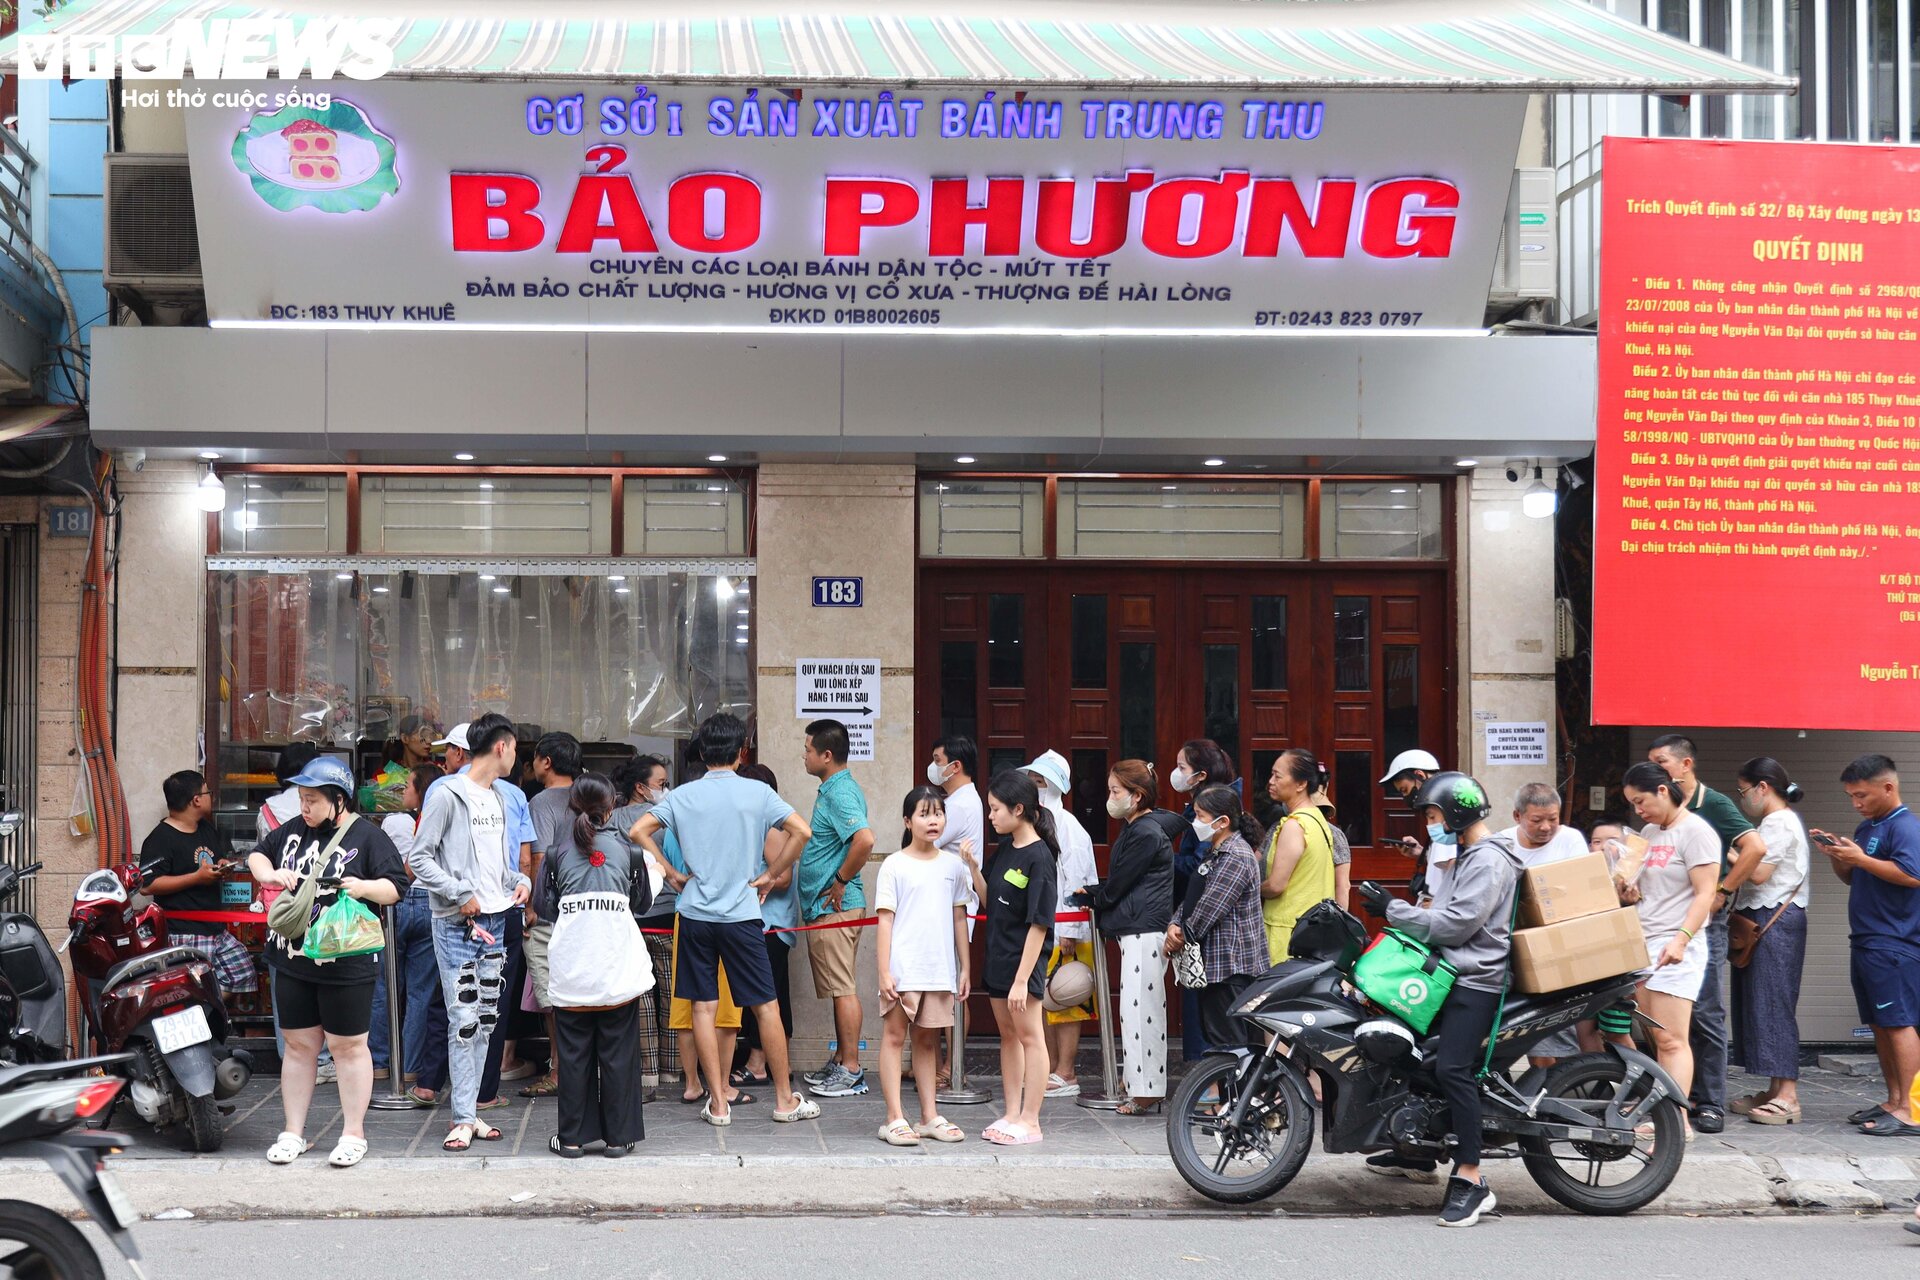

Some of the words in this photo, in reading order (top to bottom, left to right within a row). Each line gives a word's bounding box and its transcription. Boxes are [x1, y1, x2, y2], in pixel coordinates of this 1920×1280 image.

[526, 93, 584, 136] CƠ
[600, 85, 658, 136] SỞ
[707, 88, 799, 137] SẢN
[940, 92, 1063, 139] BÁNH
[1081, 99, 1225, 140] TRUNG
[1242, 99, 1325, 140] THU
[450, 143, 763, 254] BẢO
[822, 168, 1461, 259] PHƯƠNG
[1627, 198, 1662, 215] Trích
[1665, 199, 1703, 217] Quyết
[1707, 200, 1737, 218] định
[1740, 201, 1756, 217] số
[1787, 203, 1805, 222] Bộ
[1808, 204, 1832, 222] Xây
[1835, 205, 1868, 224] dựng
[1871, 207, 1903, 225] ngày
[1753, 234, 1811, 263] QUYẾT
[1817, 241, 1864, 266] ĐỊNH
[590, 257, 683, 275] CHUYÊN
[692, 257, 739, 276] CÁC
[747, 261, 798, 279] LOẠI
[806, 258, 869, 277] BÁNH
[934, 258, 982, 281] TỘC
[466, 277, 515, 298] ĐẢM
[524, 277, 569, 298] BẢO
[579, 277, 638, 298] CHẤT
[649, 281, 725, 302] LƯỢNG
[747, 282, 827, 300] HƯƠNG
[835, 285, 855, 304] VỊ
[866, 278, 899, 300] CỔ
[908, 283, 958, 300] XƯA
[975, 283, 1069, 305] THƯỢNG
[1079, 280, 1108, 301] ĐẾ
[1119, 281, 1158, 301] HÀI
[1167, 277, 1231, 302] LÒNG
[1677, 277, 1685, 290] 1.
[1692, 278, 1725, 294] Không
[1731, 279, 1756, 294] công
[1762, 281, 1788, 295] nhận
[1794, 281, 1824, 296] Quyết
[1830, 283, 1853, 296] định
[1859, 284, 1871, 297] số
[344, 305, 395, 322] THỤY
[403, 302, 455, 320] KHUÊ
[769, 308, 825, 323] ĐKKD
[835, 309, 940, 324] 01B8002605
[1340, 311, 1372, 325] 823
[1380, 312, 1423, 326] 0797
[1626, 298, 1690, 313] 23/07/2008
[1694, 301, 1713, 313] của
[1717, 299, 1731, 315] Ủy
[1735, 302, 1754, 314] ban
[1758, 303, 1783, 315] nhân
[1787, 304, 1807, 316] dân
[1810, 304, 1840, 317] thành
[1844, 305, 1864, 318] phố
[1868, 306, 1882, 318] Hà
[1886, 306, 1903, 319] Nội
[1626, 320, 1655, 334] khiếu
[1658, 322, 1674, 336] nại
[1678, 322, 1697, 335] của
[1699, 323, 1719, 337] ông
[1722, 322, 1760, 338] Nguyễn
[1764, 324, 1784, 337] Văn
[1786, 325, 1804, 340] Đại
[1807, 326, 1823, 338] đòi
[1860, 328, 1873, 340] sở
[1876, 328, 1896, 340] hữu
[1898, 330, 1918, 341] căn
[1625, 342, 1654, 356] Khuê,
[1657, 343, 1672, 356] Hà
[1674, 343, 1694, 358] Nội.
[1662, 365, 1672, 378] 2.
[1675, 362, 1689, 380] Ủy
[1691, 366, 1712, 378] ban
[1713, 367, 1740, 379] nhân
[1741, 367, 1762, 380] dân
[1763, 368, 1794, 381] thành
[1796, 369, 1816, 383] phố
[1818, 369, 1833, 382] Hà
[1834, 370, 1852, 384] Nội
[1855, 371, 1872, 383] chỉ
[1875, 372, 1895, 385] đạo
[1898, 372, 1916, 385] các
[57, 511, 89, 531] 181
[818, 580, 856, 603] 183
[802, 663, 816, 676] QUÝ
[818, 663, 843, 675] KHÁCH
[845, 661, 859, 675] ĐẾN
[861, 664, 875, 675] SAU
[1860, 661, 1908, 682] Nguyễn
[814, 678, 827, 689] VUI
[829, 677, 847, 689] LÒNG
[850, 676, 863, 689] XẾP
[808, 691, 827, 703] HÀNG
[830, 692, 834, 703] 1
[835, 690, 853, 703] PHÍA
[855, 692, 869, 703] SAU
